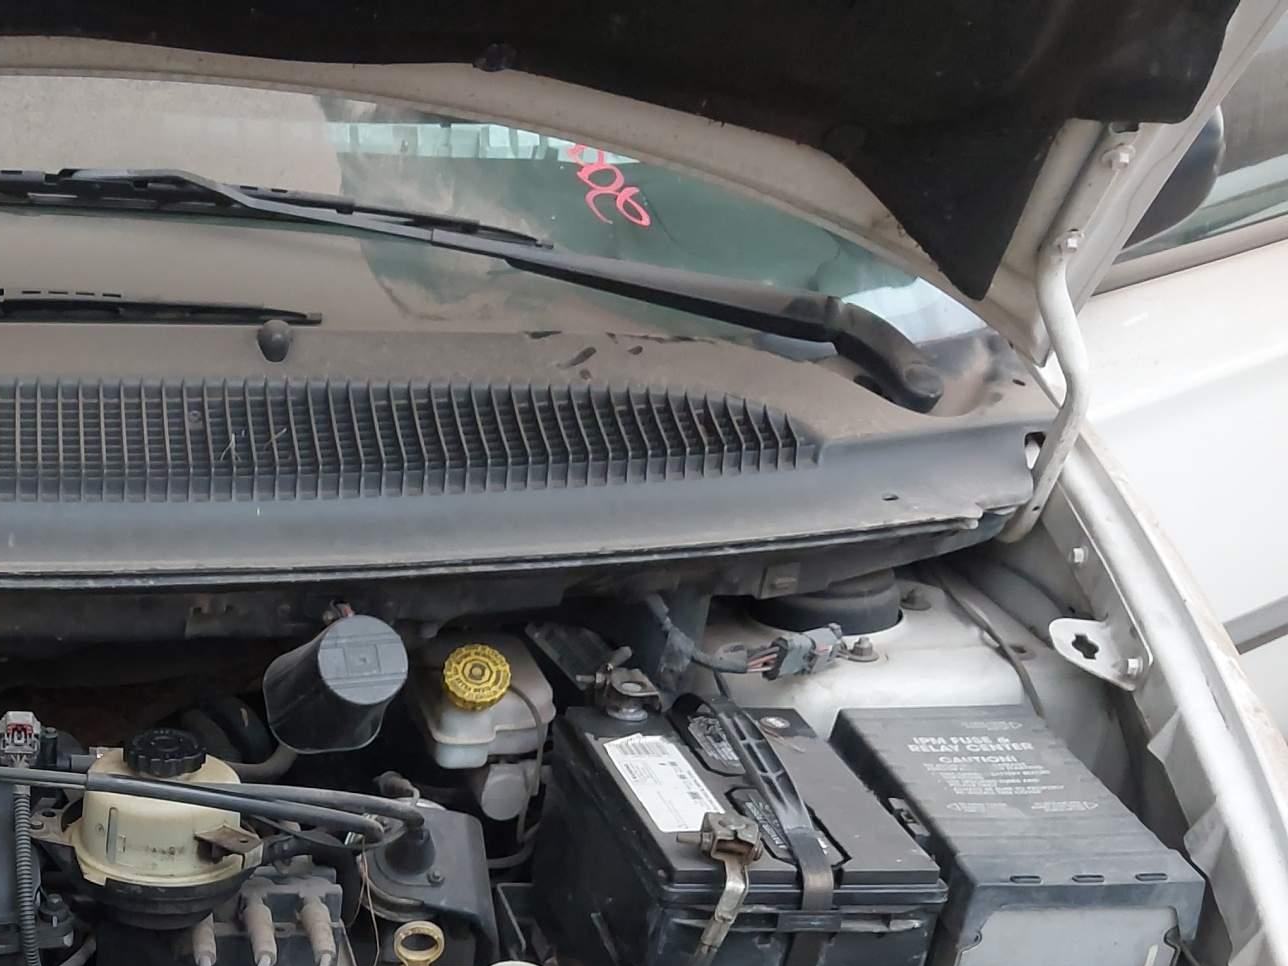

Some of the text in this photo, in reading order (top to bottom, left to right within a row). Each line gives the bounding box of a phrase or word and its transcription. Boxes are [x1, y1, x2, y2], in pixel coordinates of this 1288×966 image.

[913, 736, 947, 745] IPM
[950, 736, 992, 744] FUSE
[907, 742, 1034, 753] RELAY CENTER
